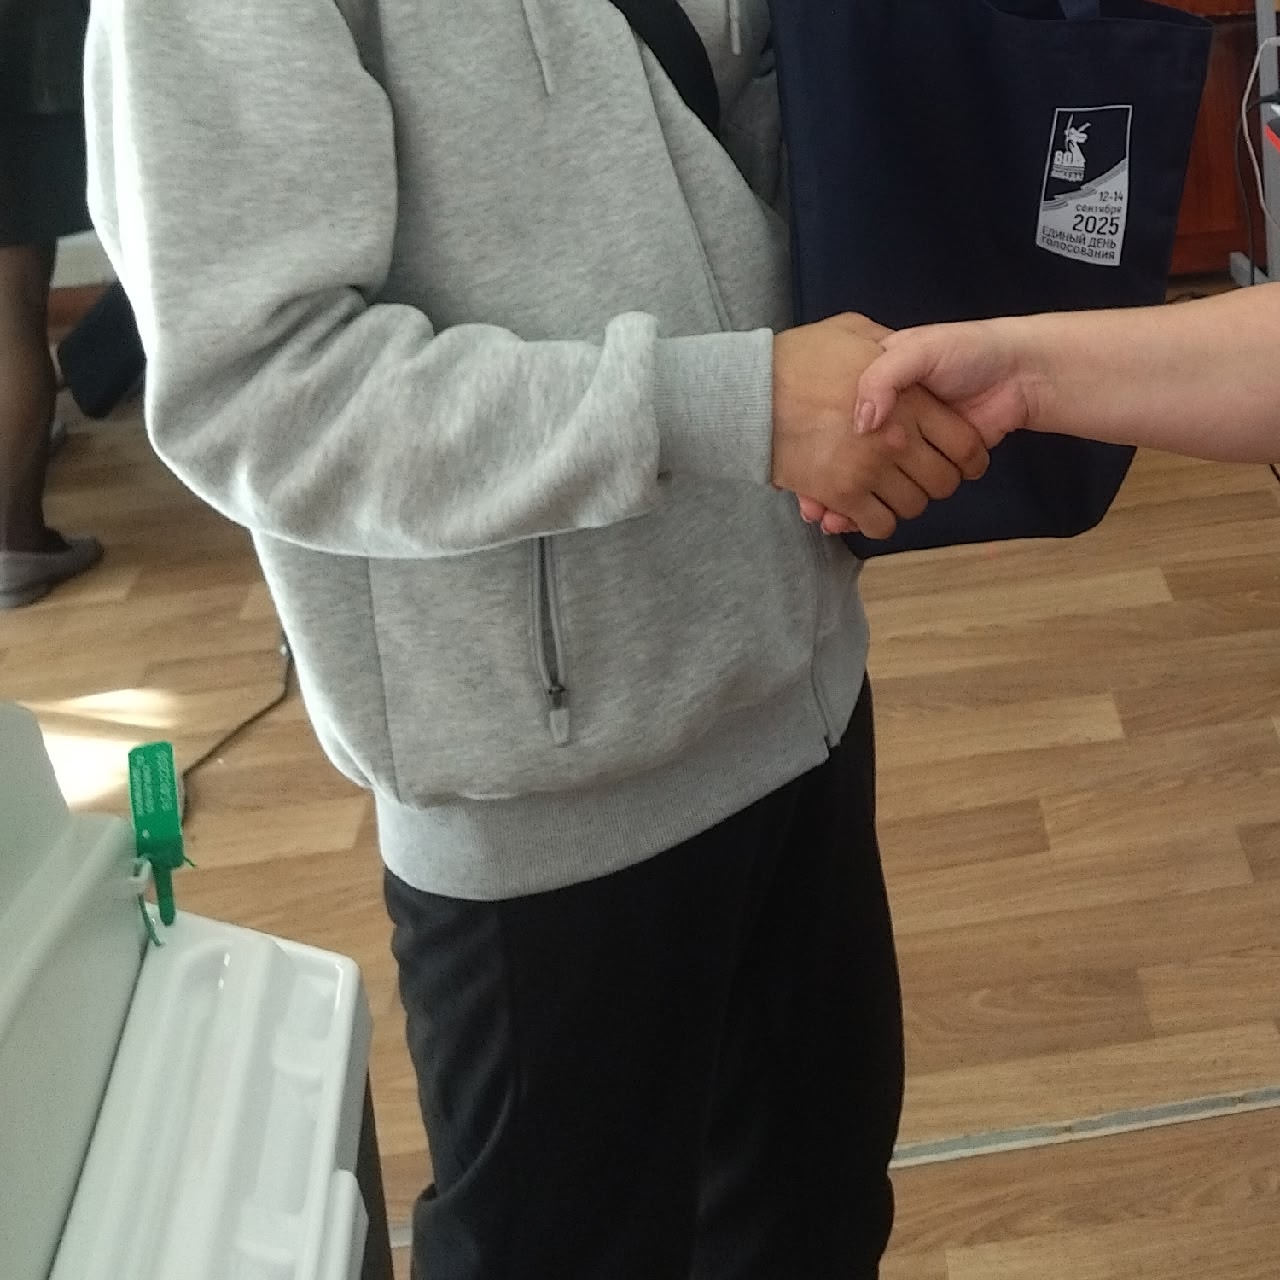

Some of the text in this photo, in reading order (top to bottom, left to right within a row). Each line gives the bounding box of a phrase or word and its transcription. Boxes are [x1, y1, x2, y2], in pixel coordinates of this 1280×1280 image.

[1100, 191, 1123, 202] 12-14
[1073, 214, 1120, 236] 2025
[1088, 237, 1116, 249] ДЕНЬ
